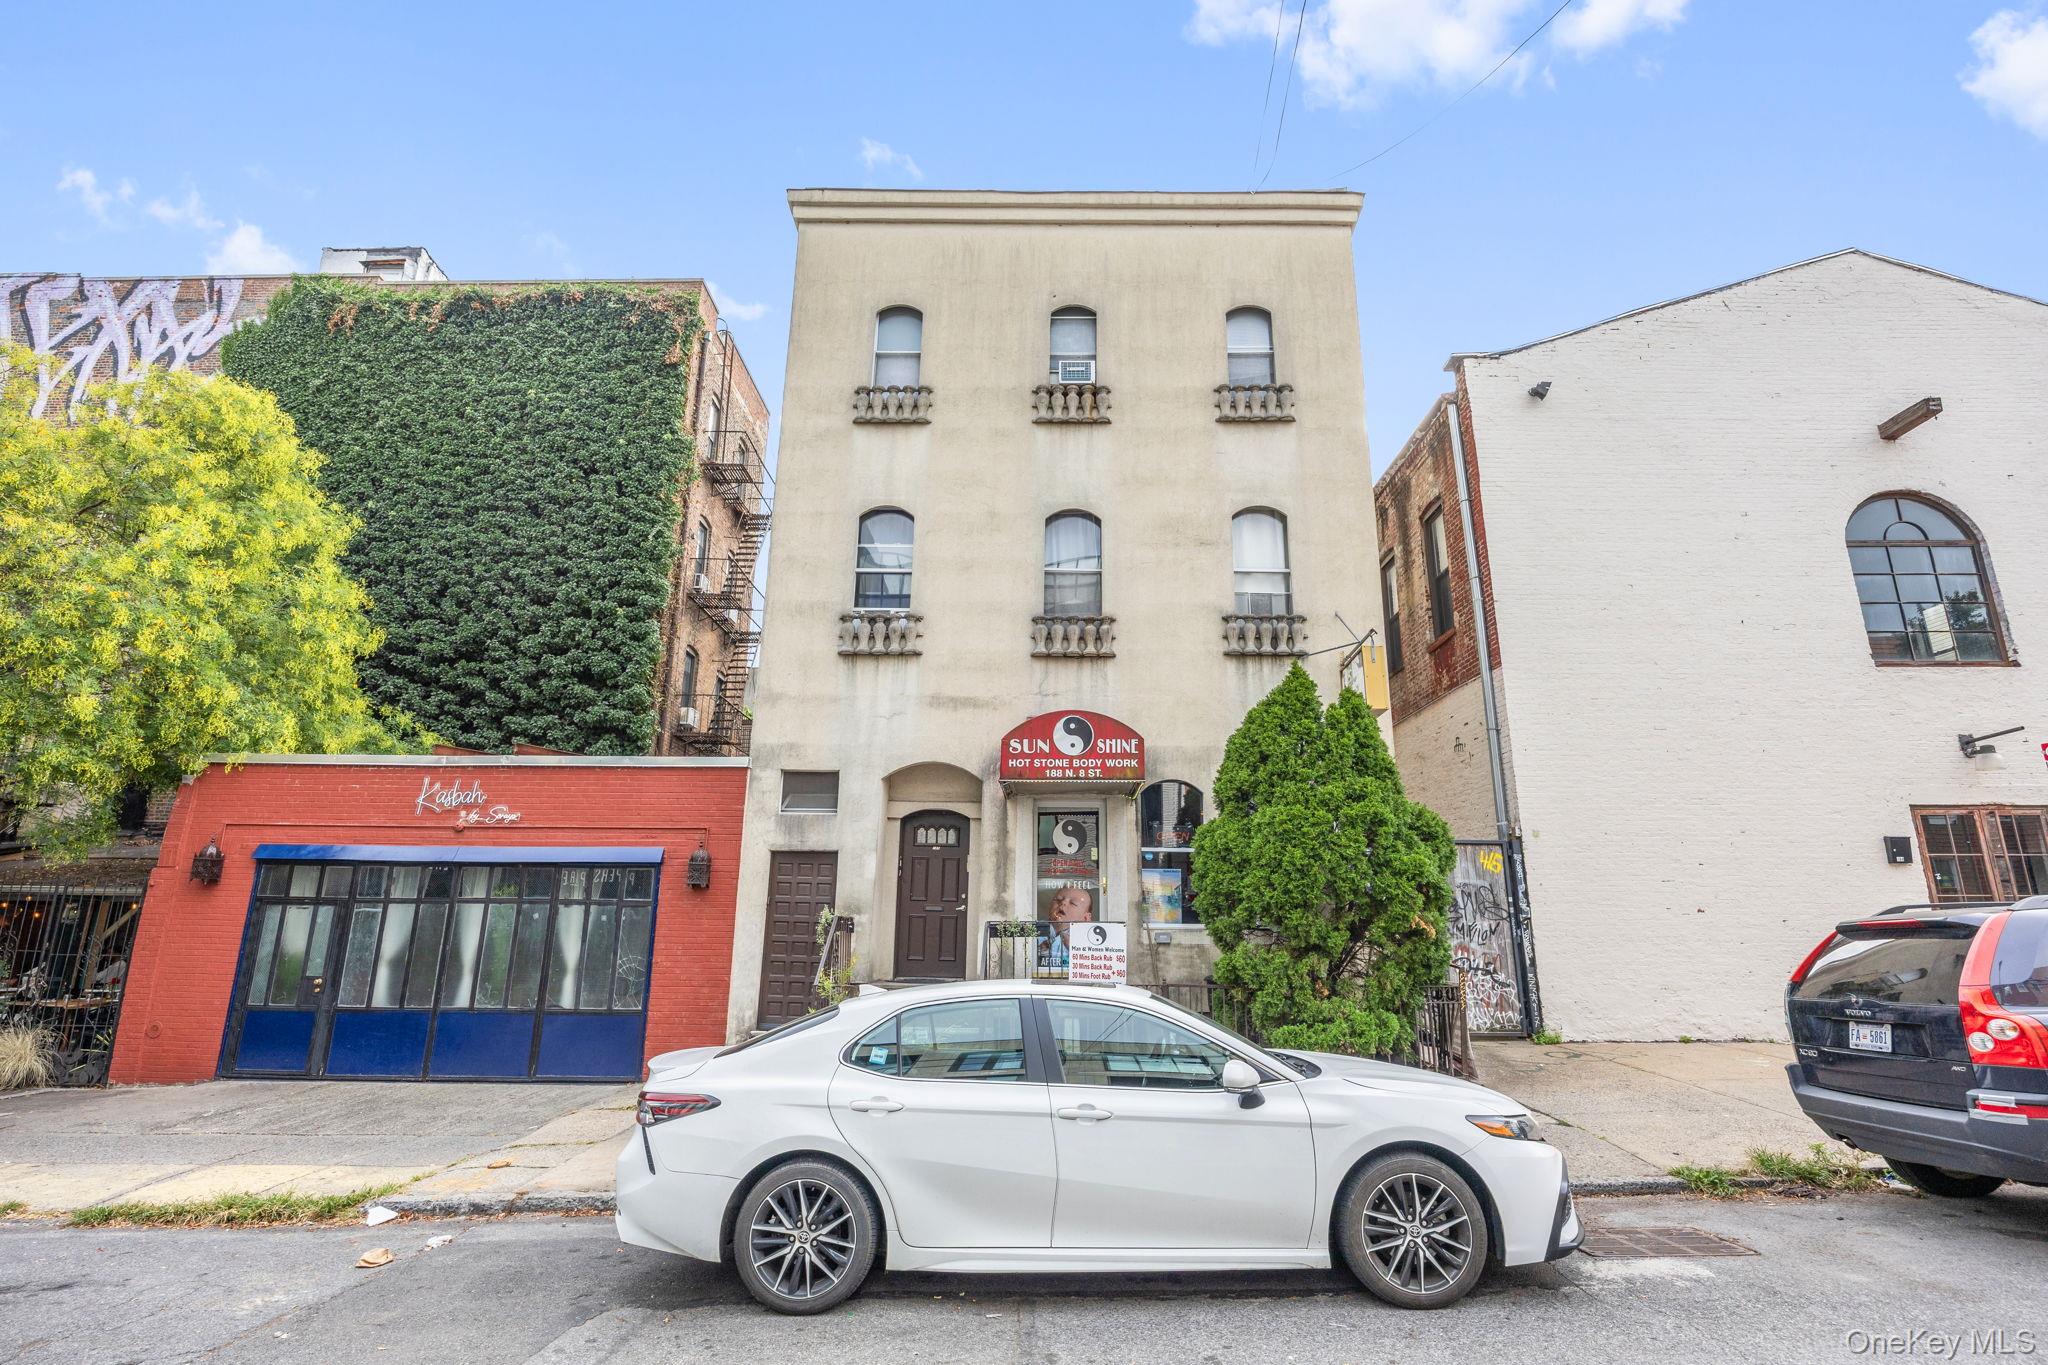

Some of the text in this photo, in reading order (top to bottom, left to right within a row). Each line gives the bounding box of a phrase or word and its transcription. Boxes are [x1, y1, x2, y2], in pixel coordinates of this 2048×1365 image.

[1009, 738, 1139, 754] SUN SHINE
[1008, 758, 1139, 768] HOT STONE BODY WORK
[1045, 769, 1103, 777] 188 N. 8 ST.
[416, 777, 486, 815] Kasbah
[1045, 880, 1064, 889] HOW
[1073, 880, 1091, 890] FEEL
[1041, 957, 1062, 967] AFTER
[1103, 954, 1113, 962] Rub
[1103, 963, 1113, 971] Rub
[1079, 971, 1090, 979] Mins
[1090, 972, 1101, 980] Foot
[1869, 1030, 1888, 1045] 5861
